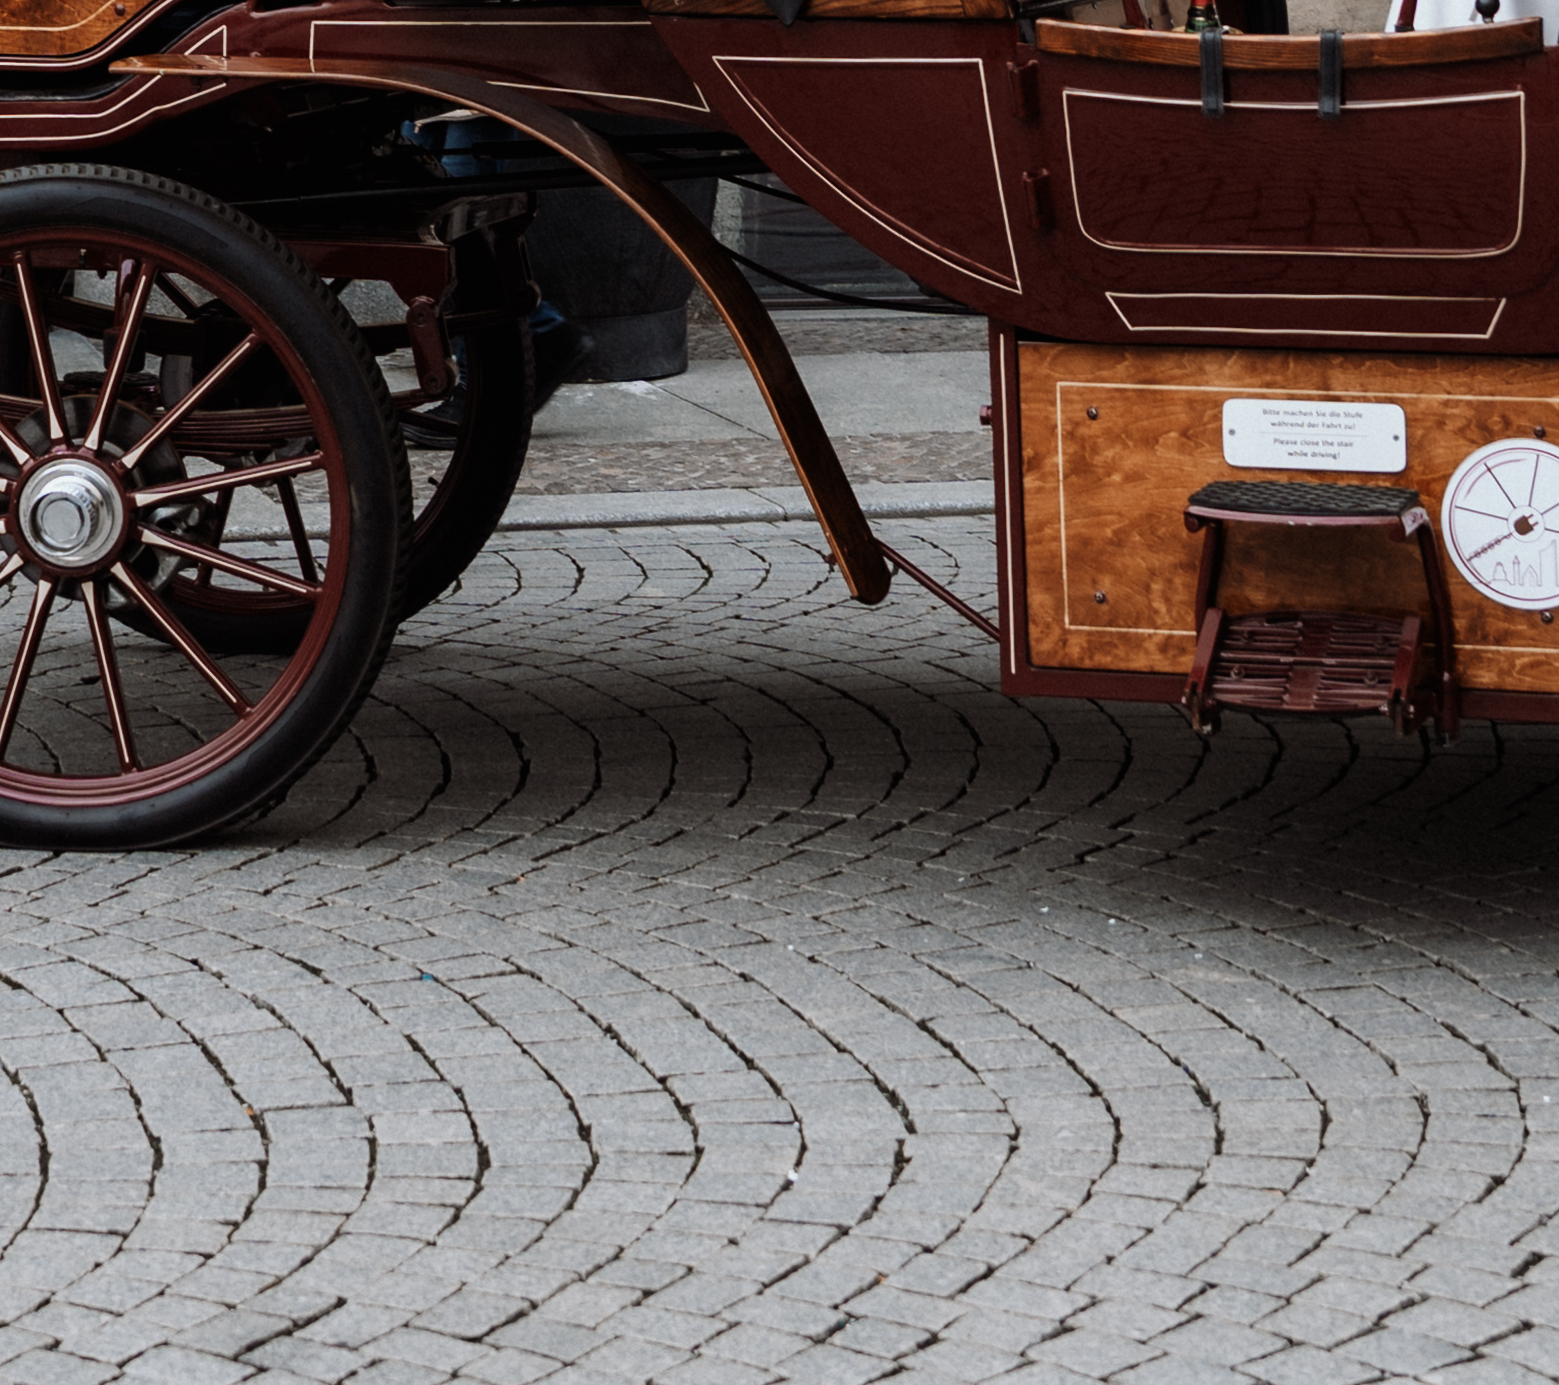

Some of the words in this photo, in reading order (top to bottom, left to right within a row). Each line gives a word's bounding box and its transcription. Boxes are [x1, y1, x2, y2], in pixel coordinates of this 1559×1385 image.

[1262, 408, 1280, 416] Bitte
[1283, 409, 1313, 417] machen
[1316, 410, 1327, 418] Sie
[1329, 410, 1341, 418] die
[1343, 411, 1363, 419] Stufe
[1270, 420, 1305, 428] während
[1307, 421, 1319, 429] der
[1322, 422, 1342, 430] Fahrt
[1273, 438, 1298, 446] Please
[1322, 439, 1335, 447] the
[1337, 440, 1354, 448] stair
[1287, 450, 1308, 458] while
[1311, 451, 1341, 460] driving!
